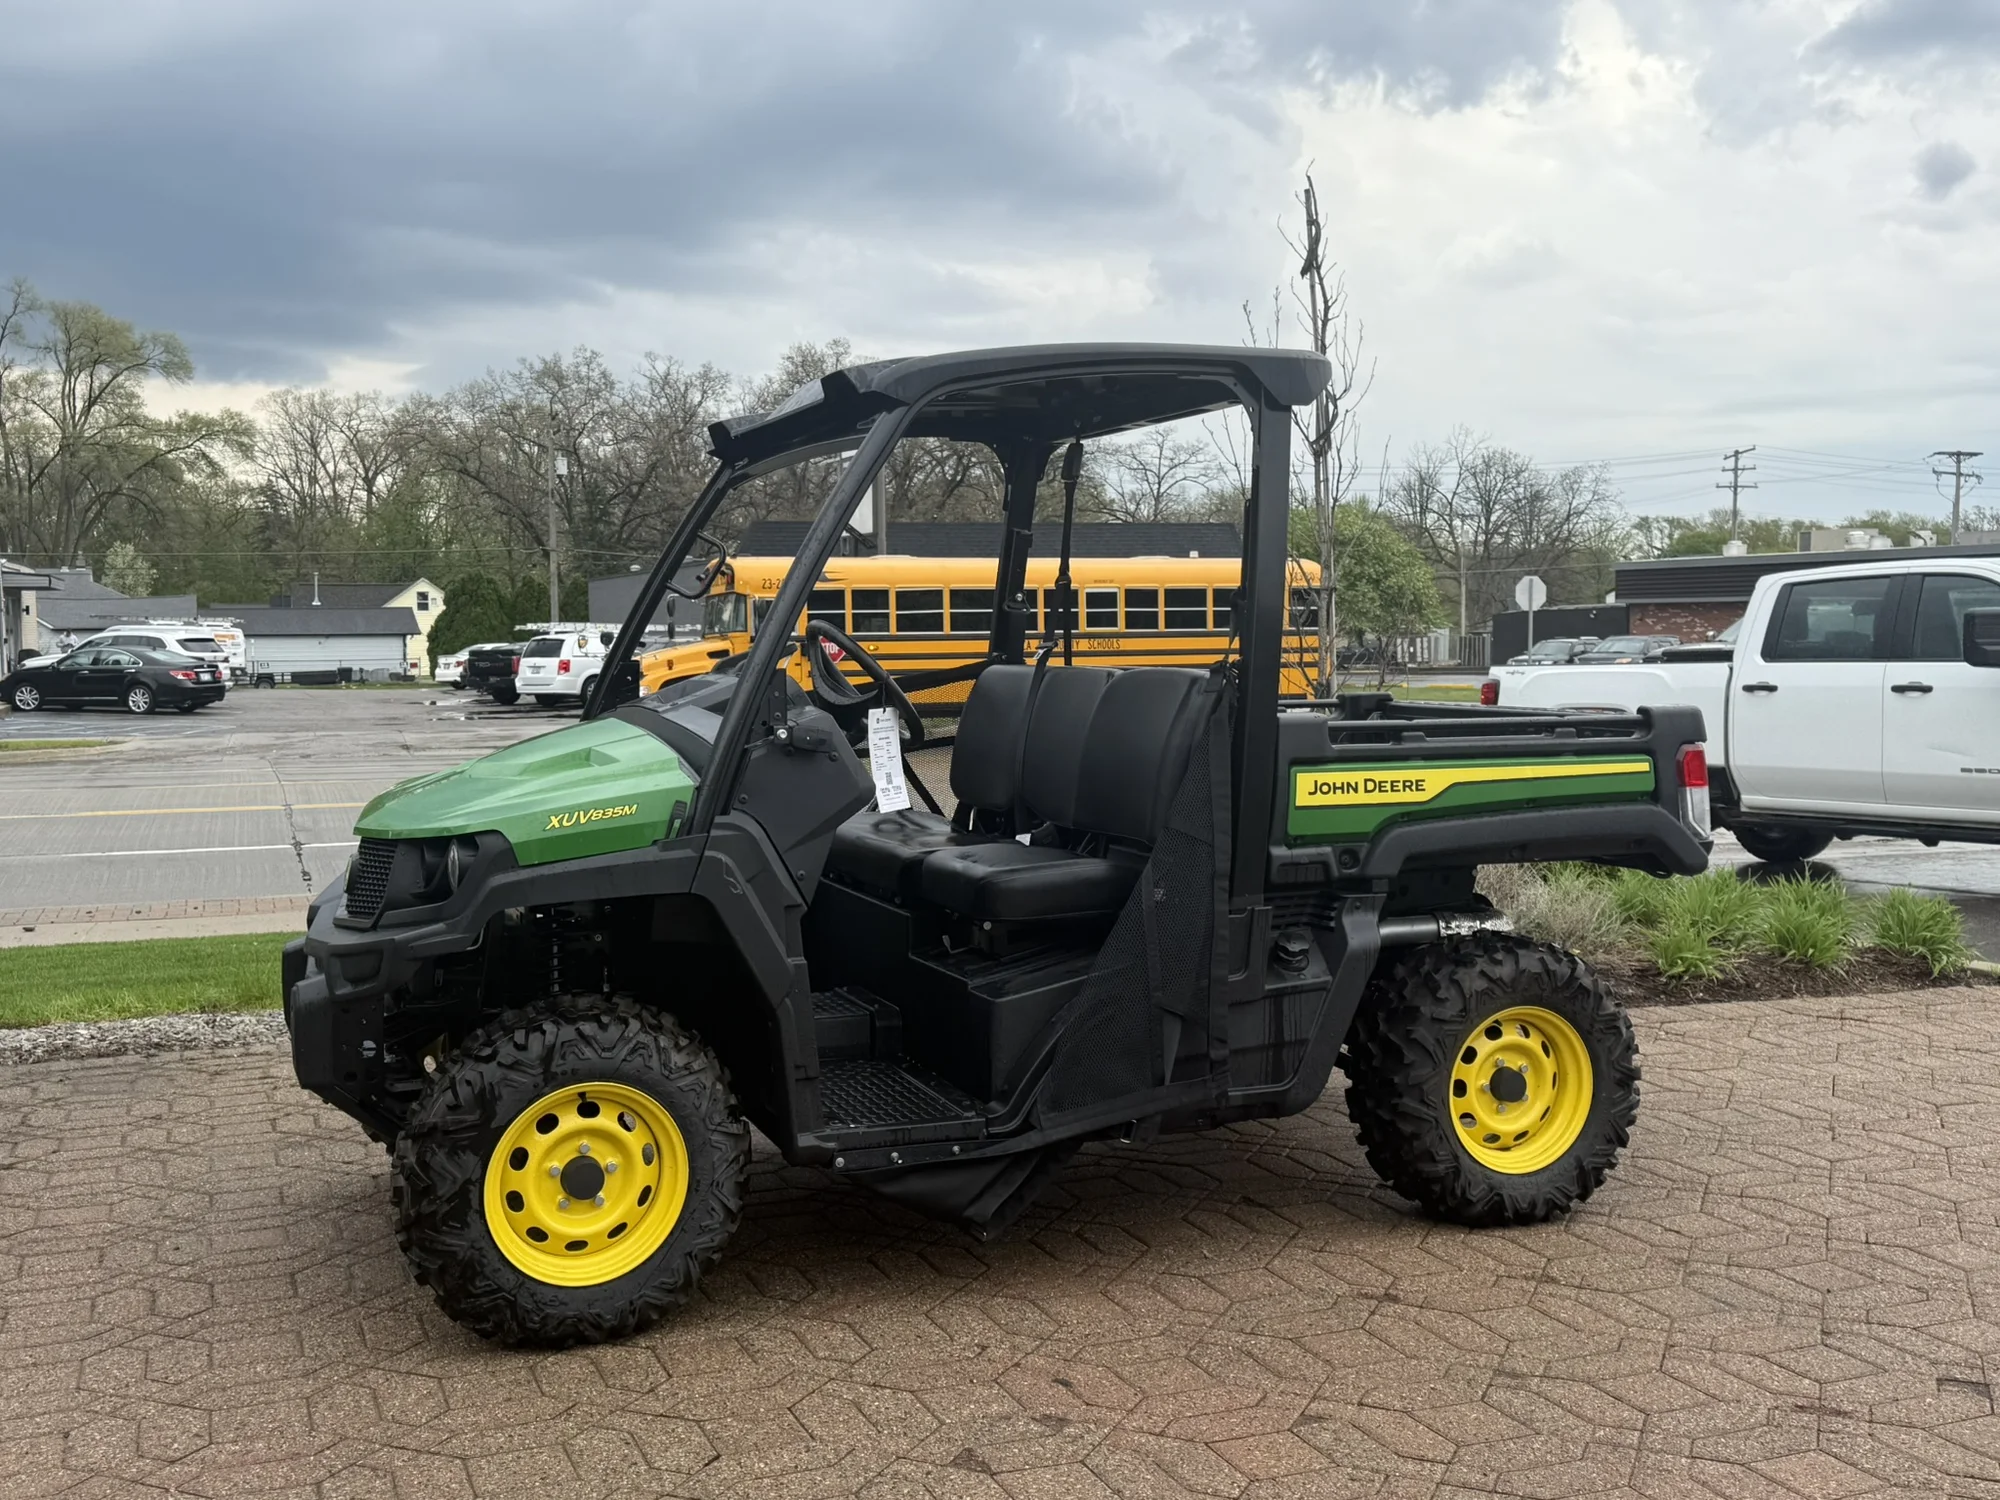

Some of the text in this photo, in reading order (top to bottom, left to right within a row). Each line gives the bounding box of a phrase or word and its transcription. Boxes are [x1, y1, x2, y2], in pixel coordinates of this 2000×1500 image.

[762, 578, 785, 589] 23-2
[1087, 640, 1121, 650] SCHOOLS
[1308, 778, 1426, 796] JOHN DEERE
[543, 804, 638, 830] XUV835M
